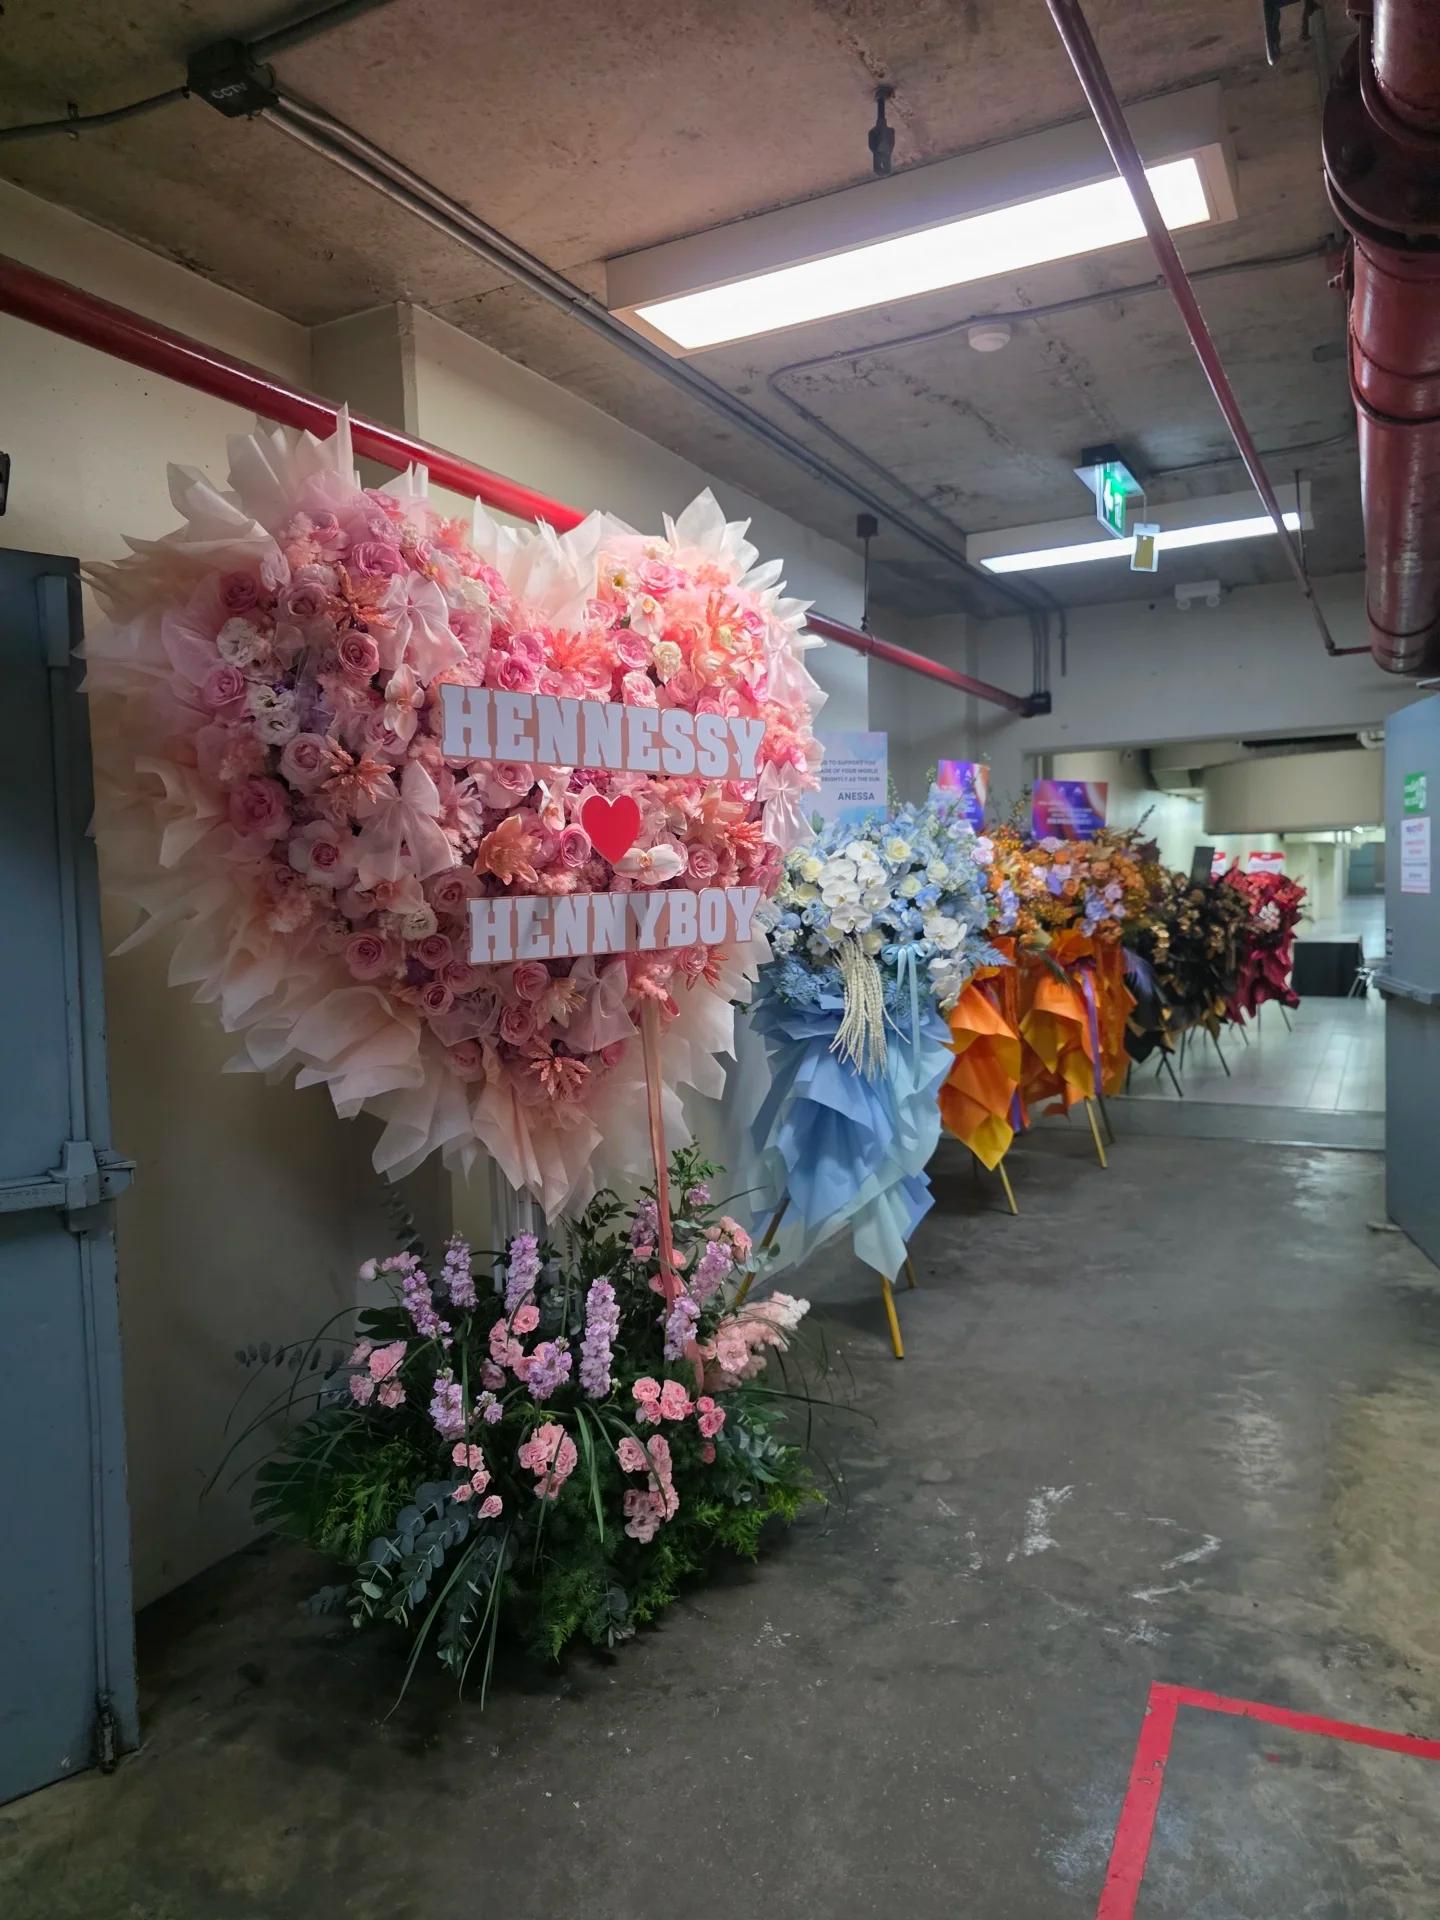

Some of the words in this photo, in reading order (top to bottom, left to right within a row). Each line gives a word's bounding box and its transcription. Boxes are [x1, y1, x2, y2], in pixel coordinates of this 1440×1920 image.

[211, 82, 247, 99] CCTV
[440, 684, 766, 780] HENNESSY
[838, 792, 875, 800] ANESSA
[468, 887, 761, 964] HENNYBOY
